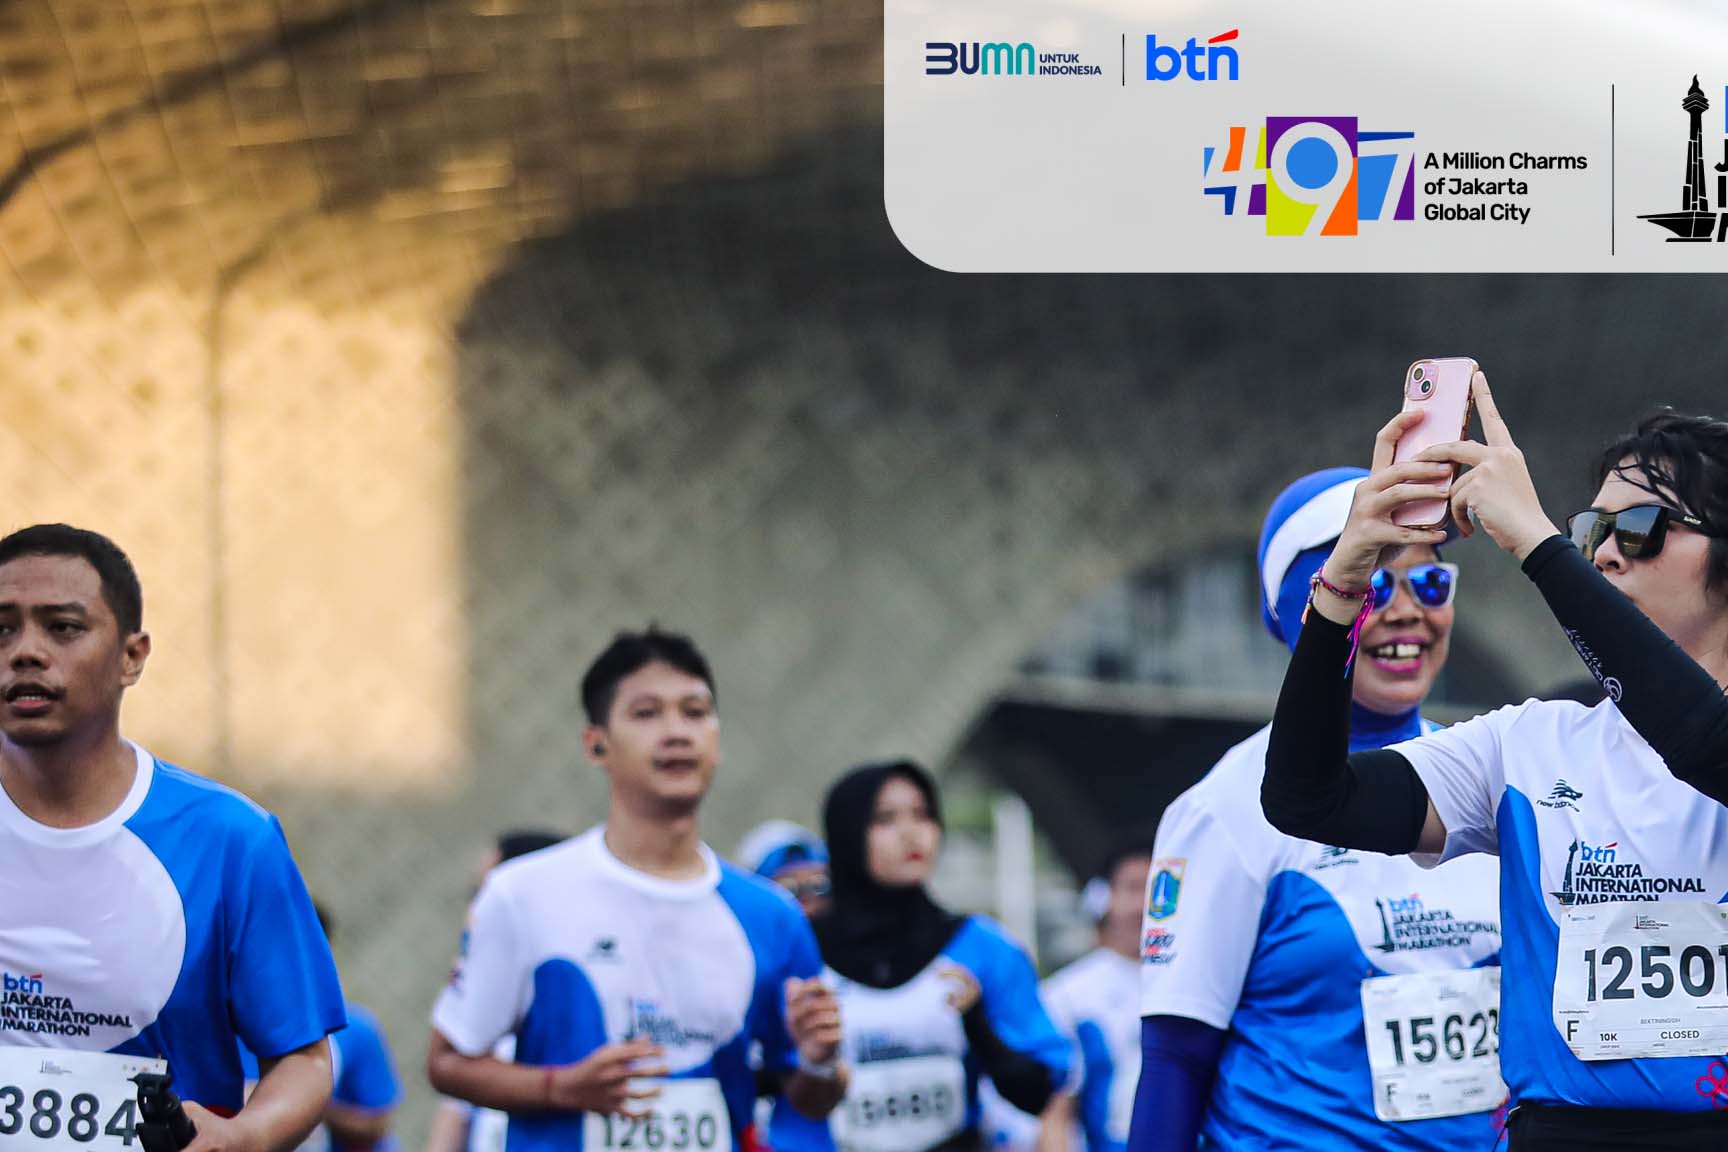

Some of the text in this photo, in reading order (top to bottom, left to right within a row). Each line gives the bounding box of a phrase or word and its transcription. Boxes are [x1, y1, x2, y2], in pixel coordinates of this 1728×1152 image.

[1575, 863, 1643, 878] JAKARTA
[1575, 877, 1706, 893] INTERNATIONAL
[0, 991, 74, 1011] JAKARTA
[0, 1005, 133, 1028] INTERNATIONAL
[2, 1018, 91, 1037] MARATHON
[1566, 1019, 1580, 1042] F
[1599, 1033, 1618, 1042] 10K
[1660, 1030, 1700, 1040] CLOSED
[0, 1085, 138, 1147] 3884
[603, 1111, 717, 1149] 12630
